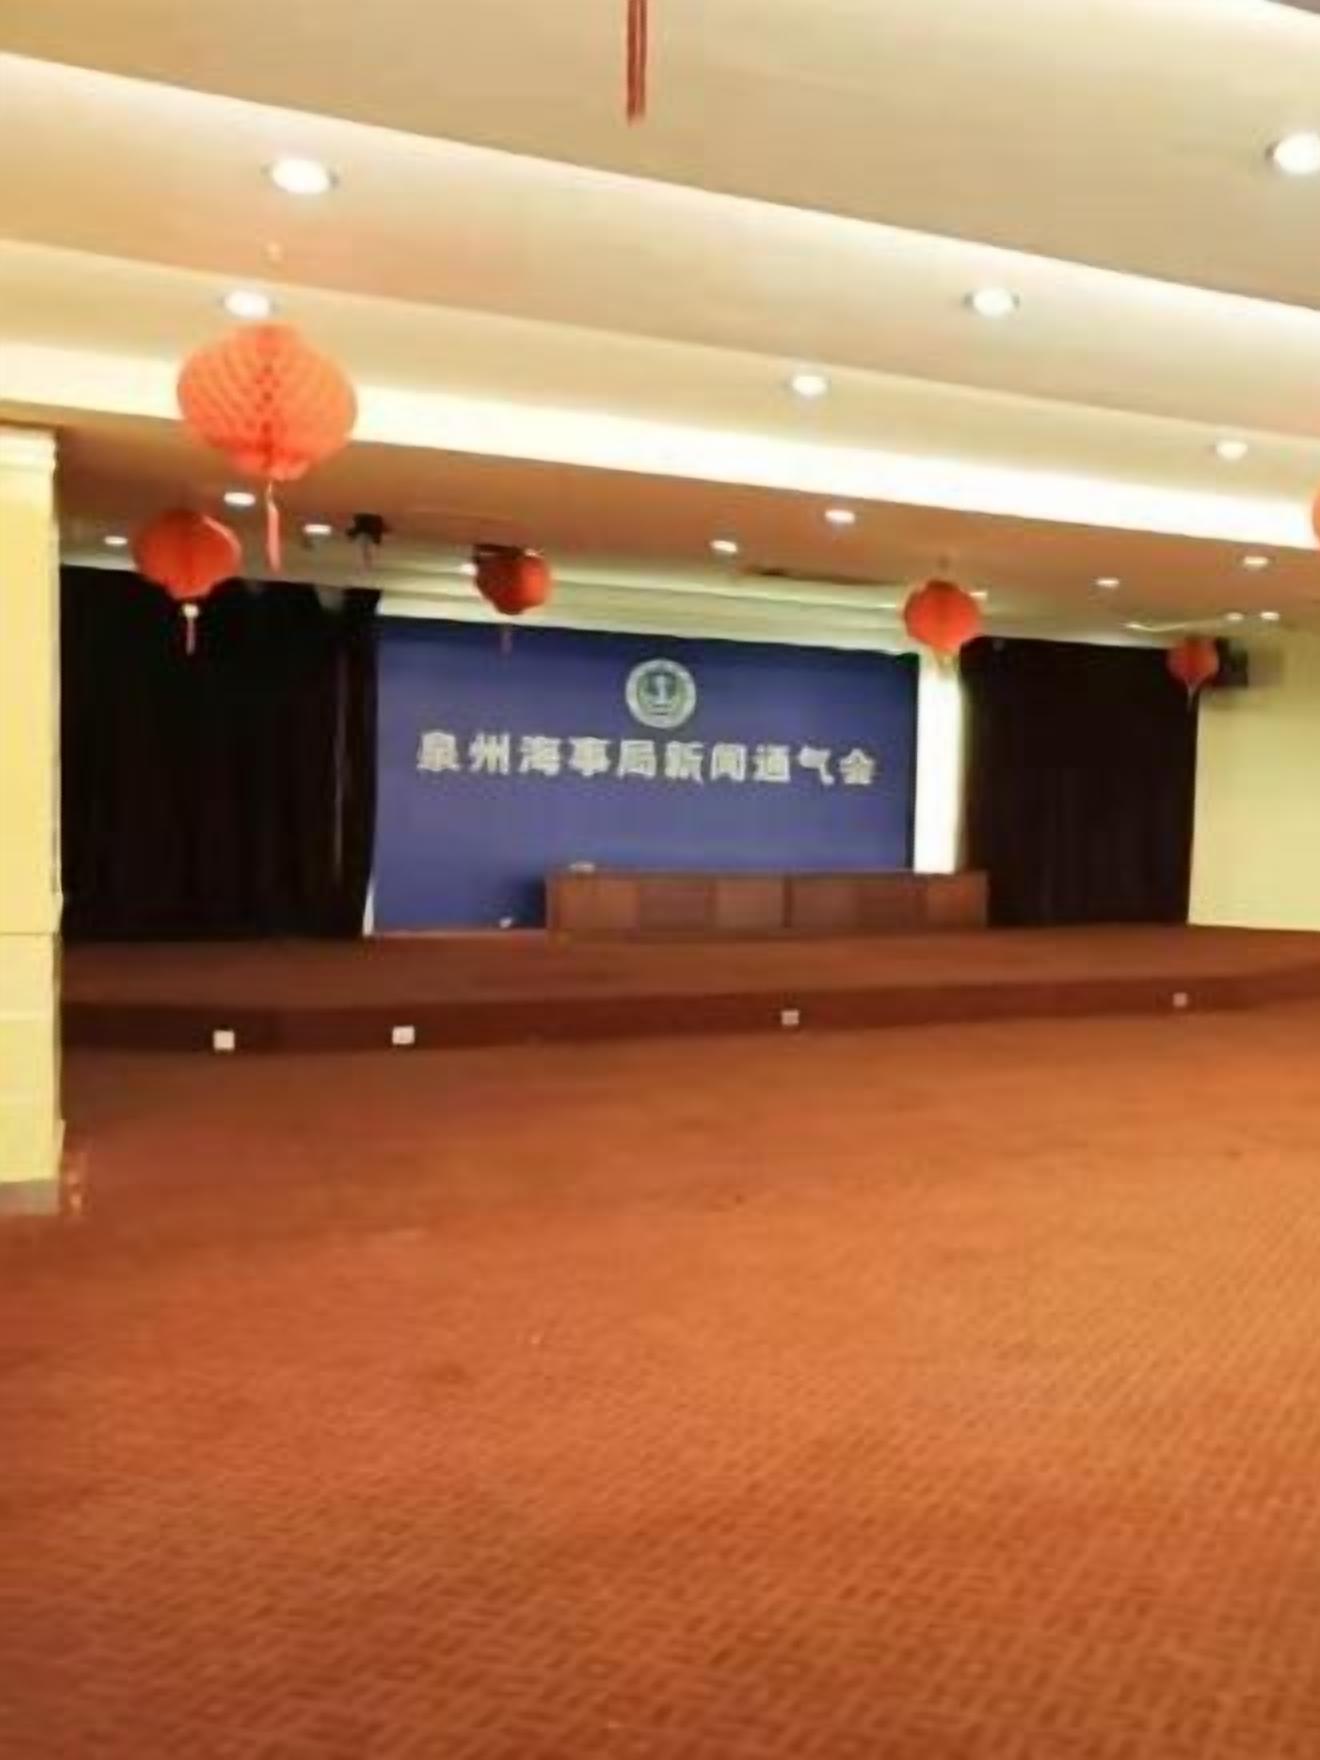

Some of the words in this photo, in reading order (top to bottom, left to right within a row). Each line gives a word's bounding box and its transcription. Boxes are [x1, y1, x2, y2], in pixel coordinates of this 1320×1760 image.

[416, 731, 876, 785] 泉州海事局新闻通气会
